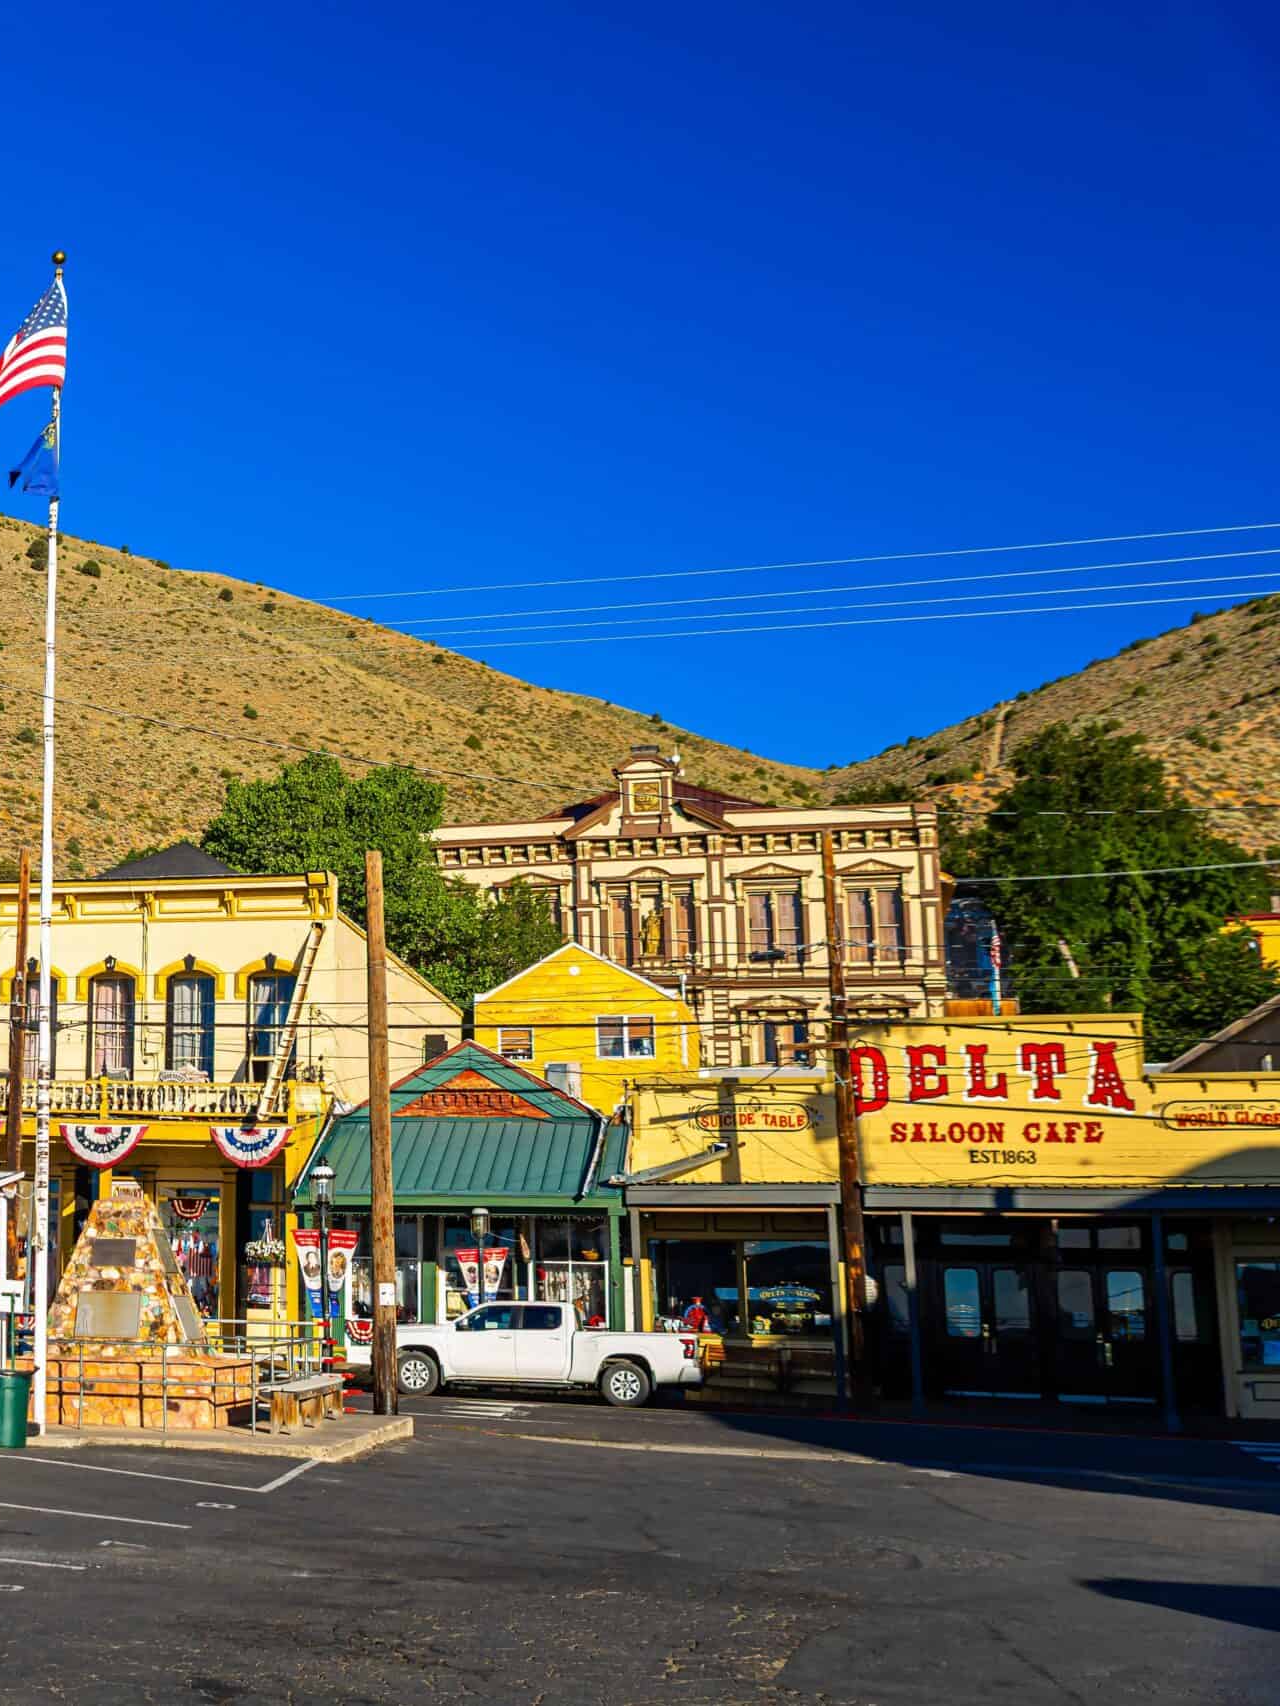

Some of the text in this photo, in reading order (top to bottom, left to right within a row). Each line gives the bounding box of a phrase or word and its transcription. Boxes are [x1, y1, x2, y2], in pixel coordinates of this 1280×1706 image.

[849, 1041, 1136, 1118] DELTA
[699, 1112, 806, 1128] SUICIDE TABLE
[890, 1121, 1104, 1144] SALOON CAFE
